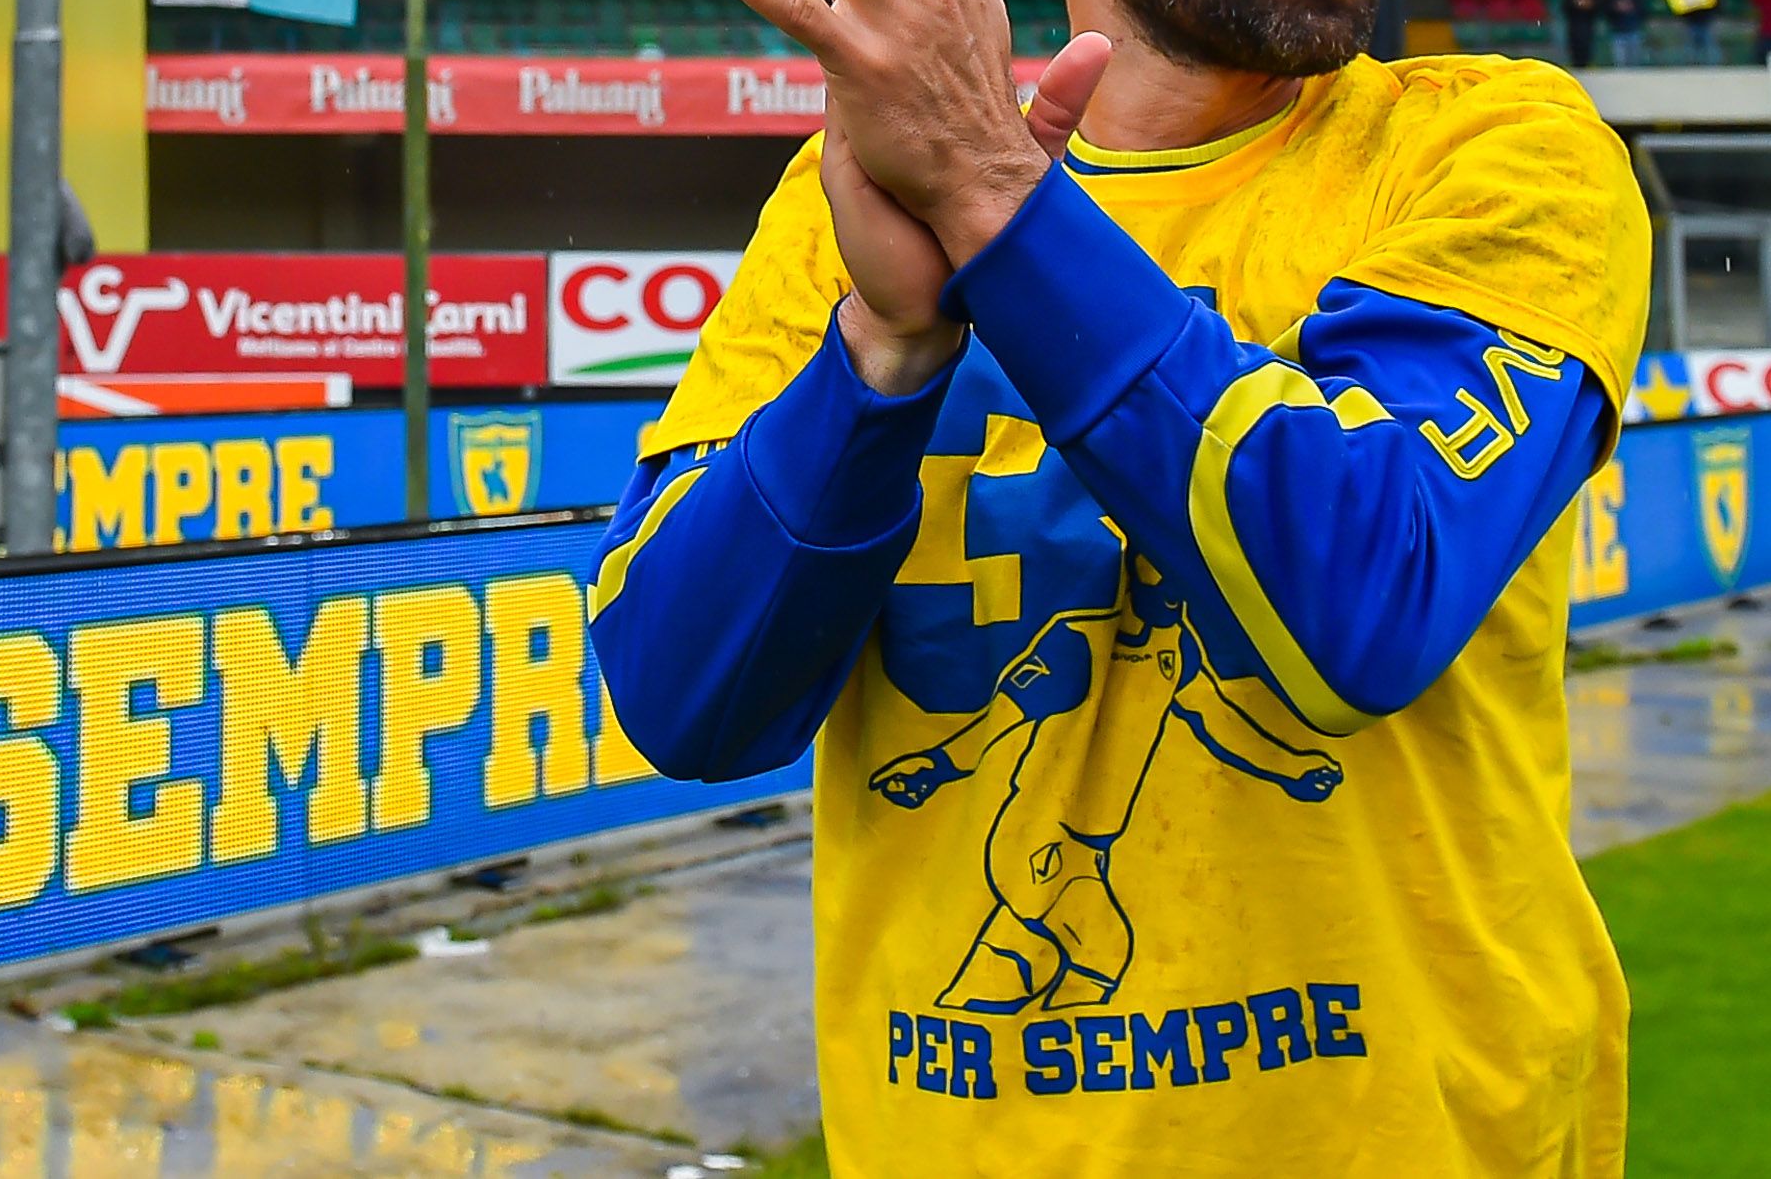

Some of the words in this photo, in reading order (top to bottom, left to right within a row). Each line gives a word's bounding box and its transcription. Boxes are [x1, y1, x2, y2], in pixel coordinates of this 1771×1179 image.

[196, 286, 404, 339] Vicentini
[888, 1009, 998, 1100] PER
[1021, 982, 1368, 1097] SEMPRE
